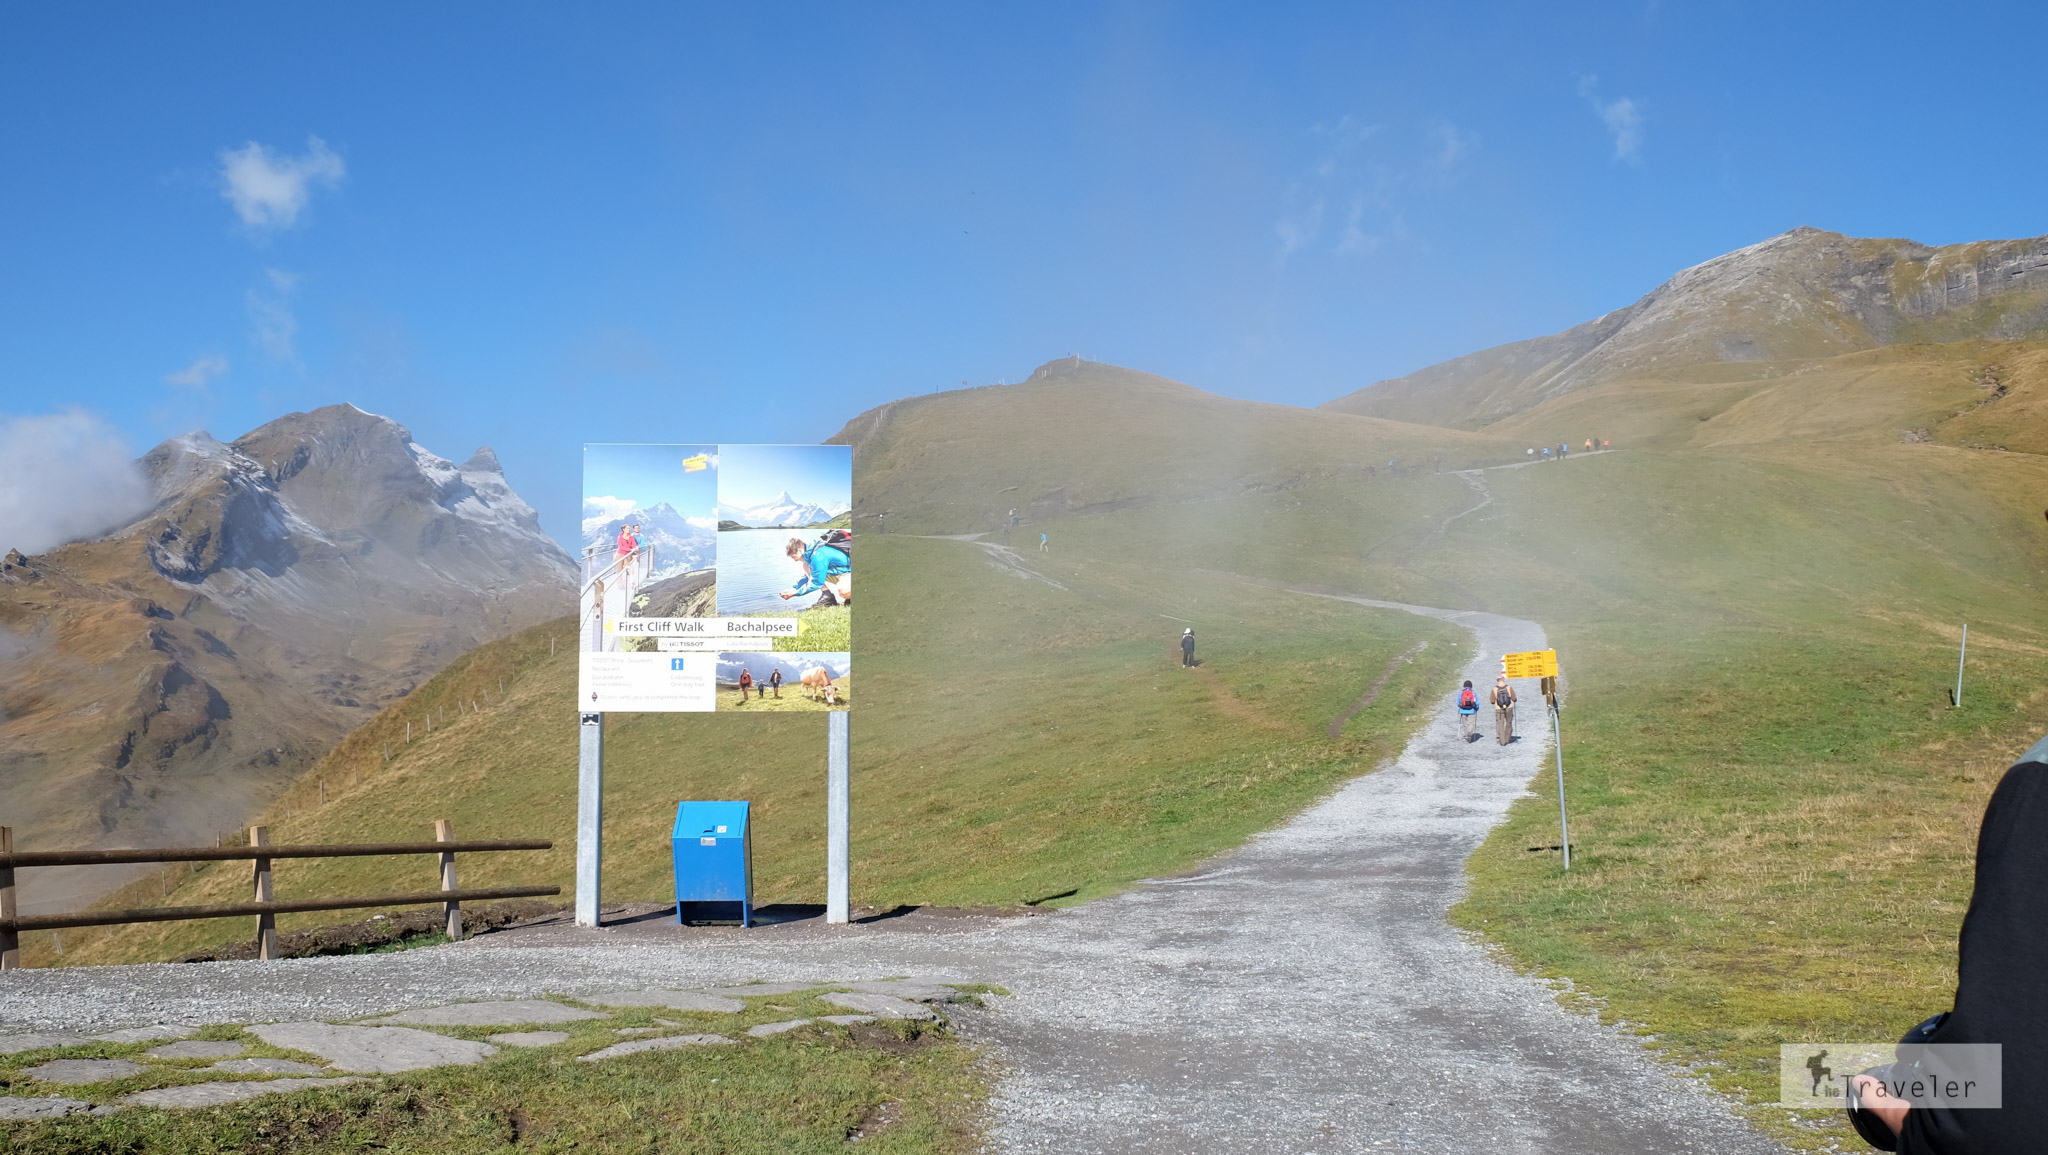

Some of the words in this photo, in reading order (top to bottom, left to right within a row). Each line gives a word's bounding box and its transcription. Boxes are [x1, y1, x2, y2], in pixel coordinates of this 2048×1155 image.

[619, 621, 643, 632] First
[647, 621, 671, 632] Cliff
[674, 621, 704, 632] Walk
[727, 621, 793, 634] Bachalpsee
